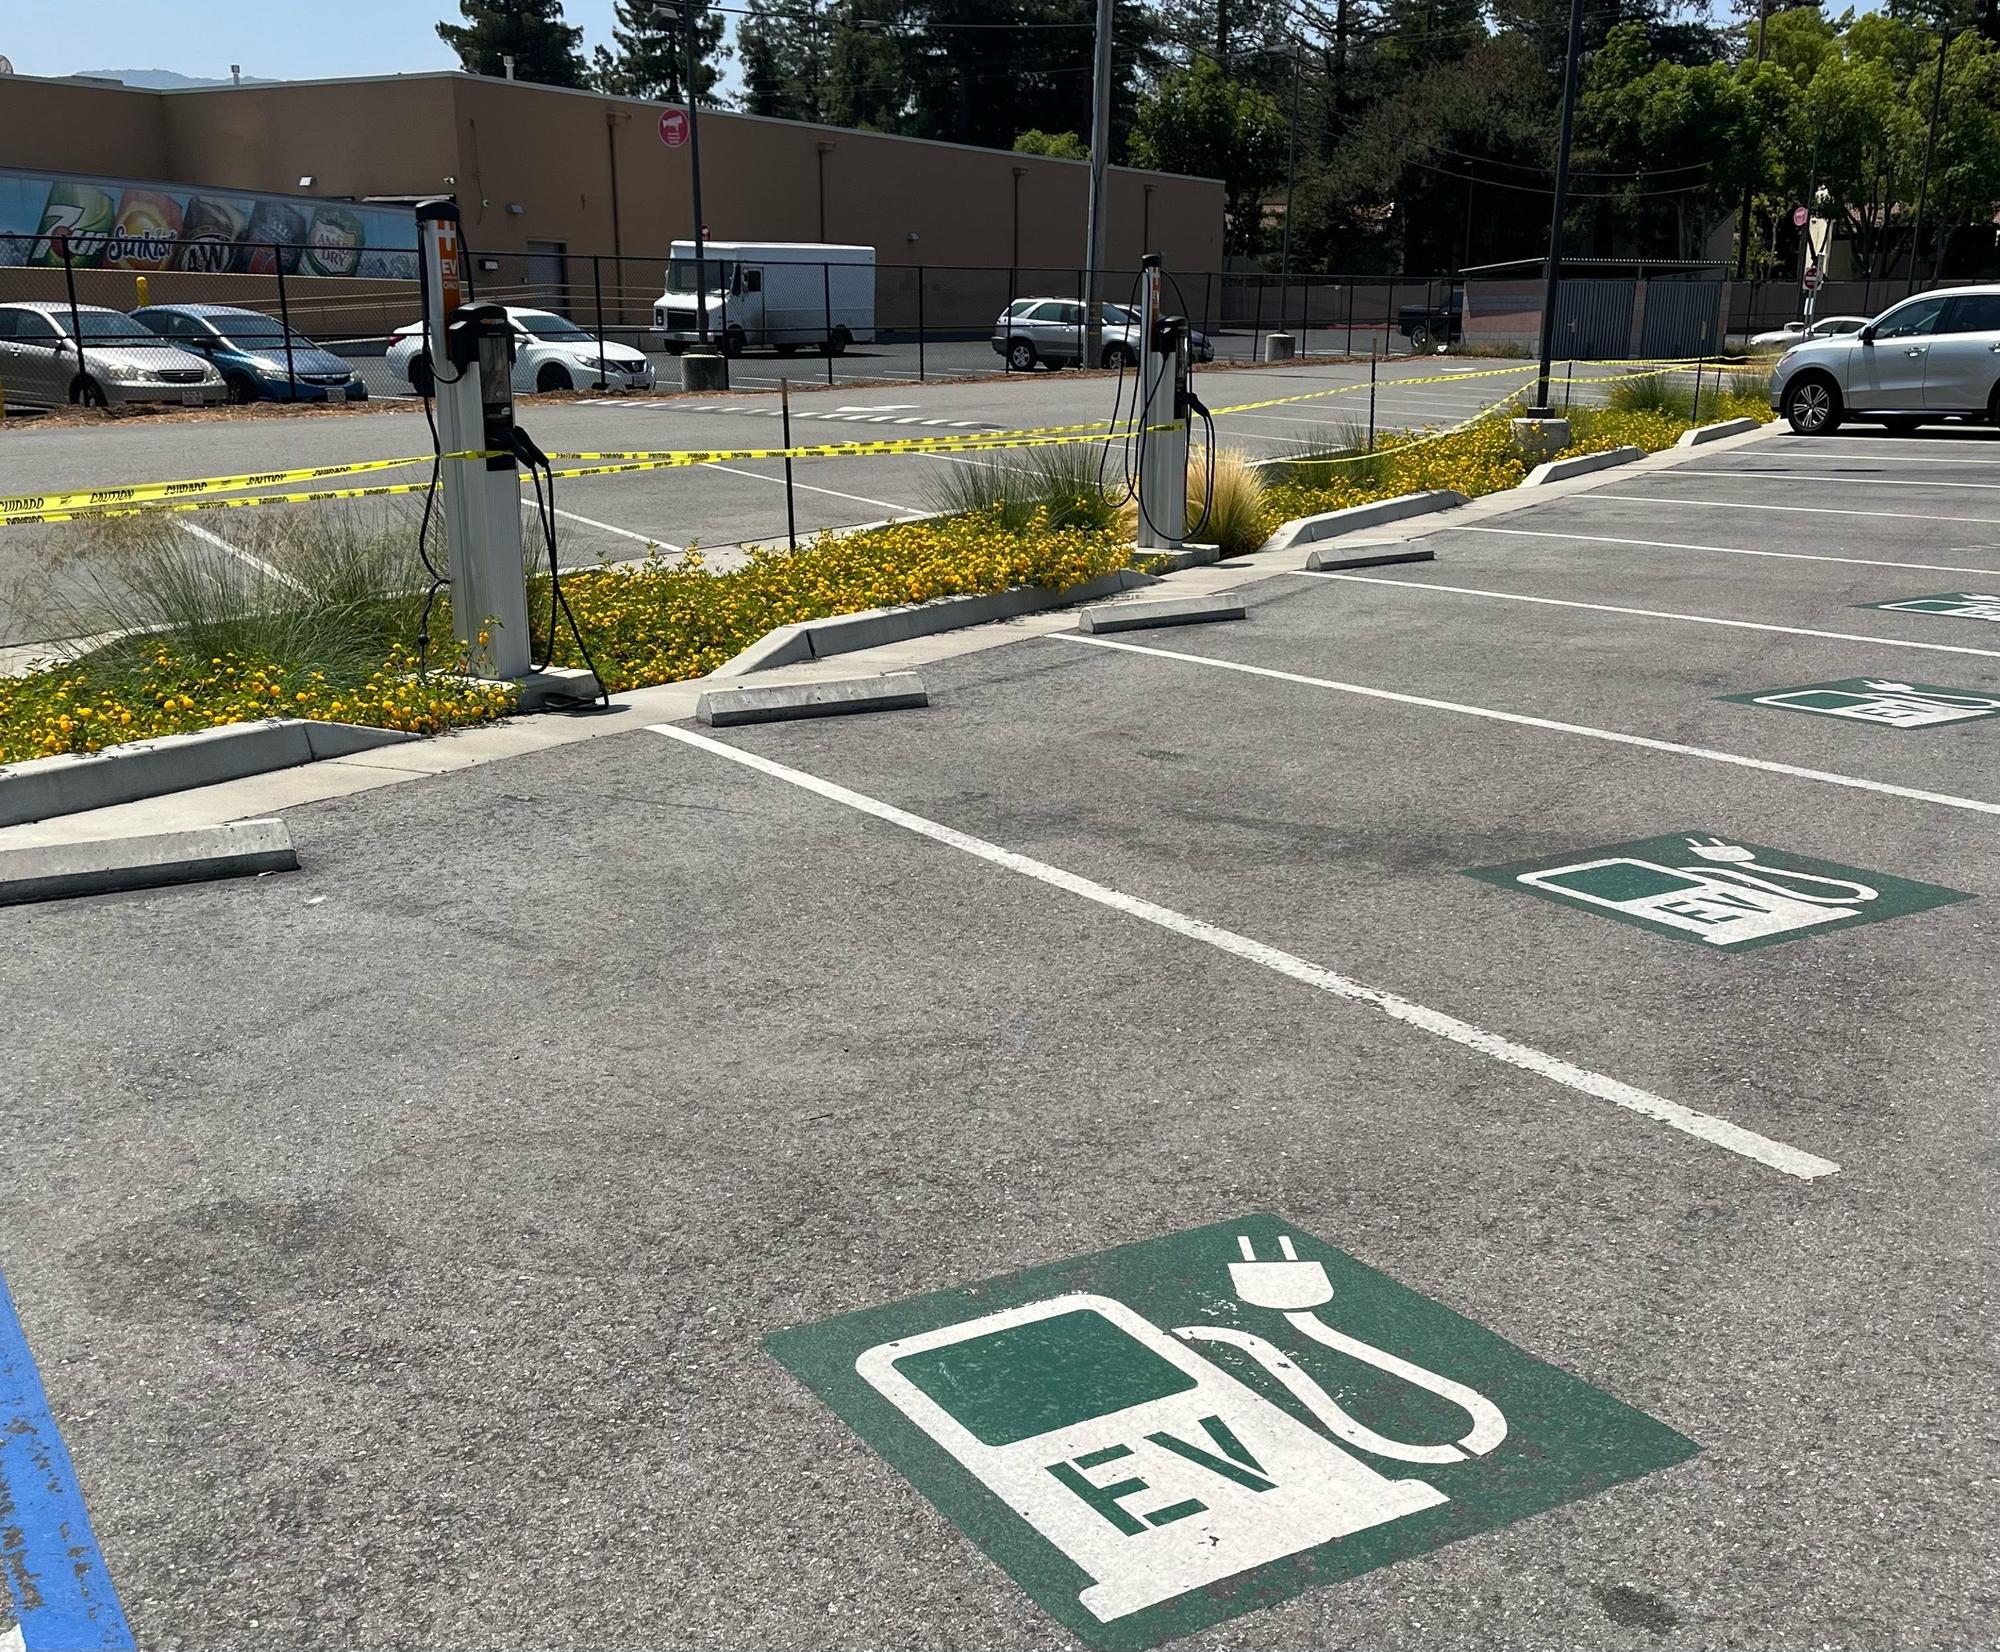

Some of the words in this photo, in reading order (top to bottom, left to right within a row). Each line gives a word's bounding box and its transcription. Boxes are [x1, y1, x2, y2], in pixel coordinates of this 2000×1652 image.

[107, 223, 178, 262] Sunkist
[442, 259, 457, 275] EV
[90, 489, 134, 504] CAUTION
[1853, 704, 1934, 719] EV
[1653, 892, 1771, 924] EV
[1045, 1415, 1279, 1536] EV
